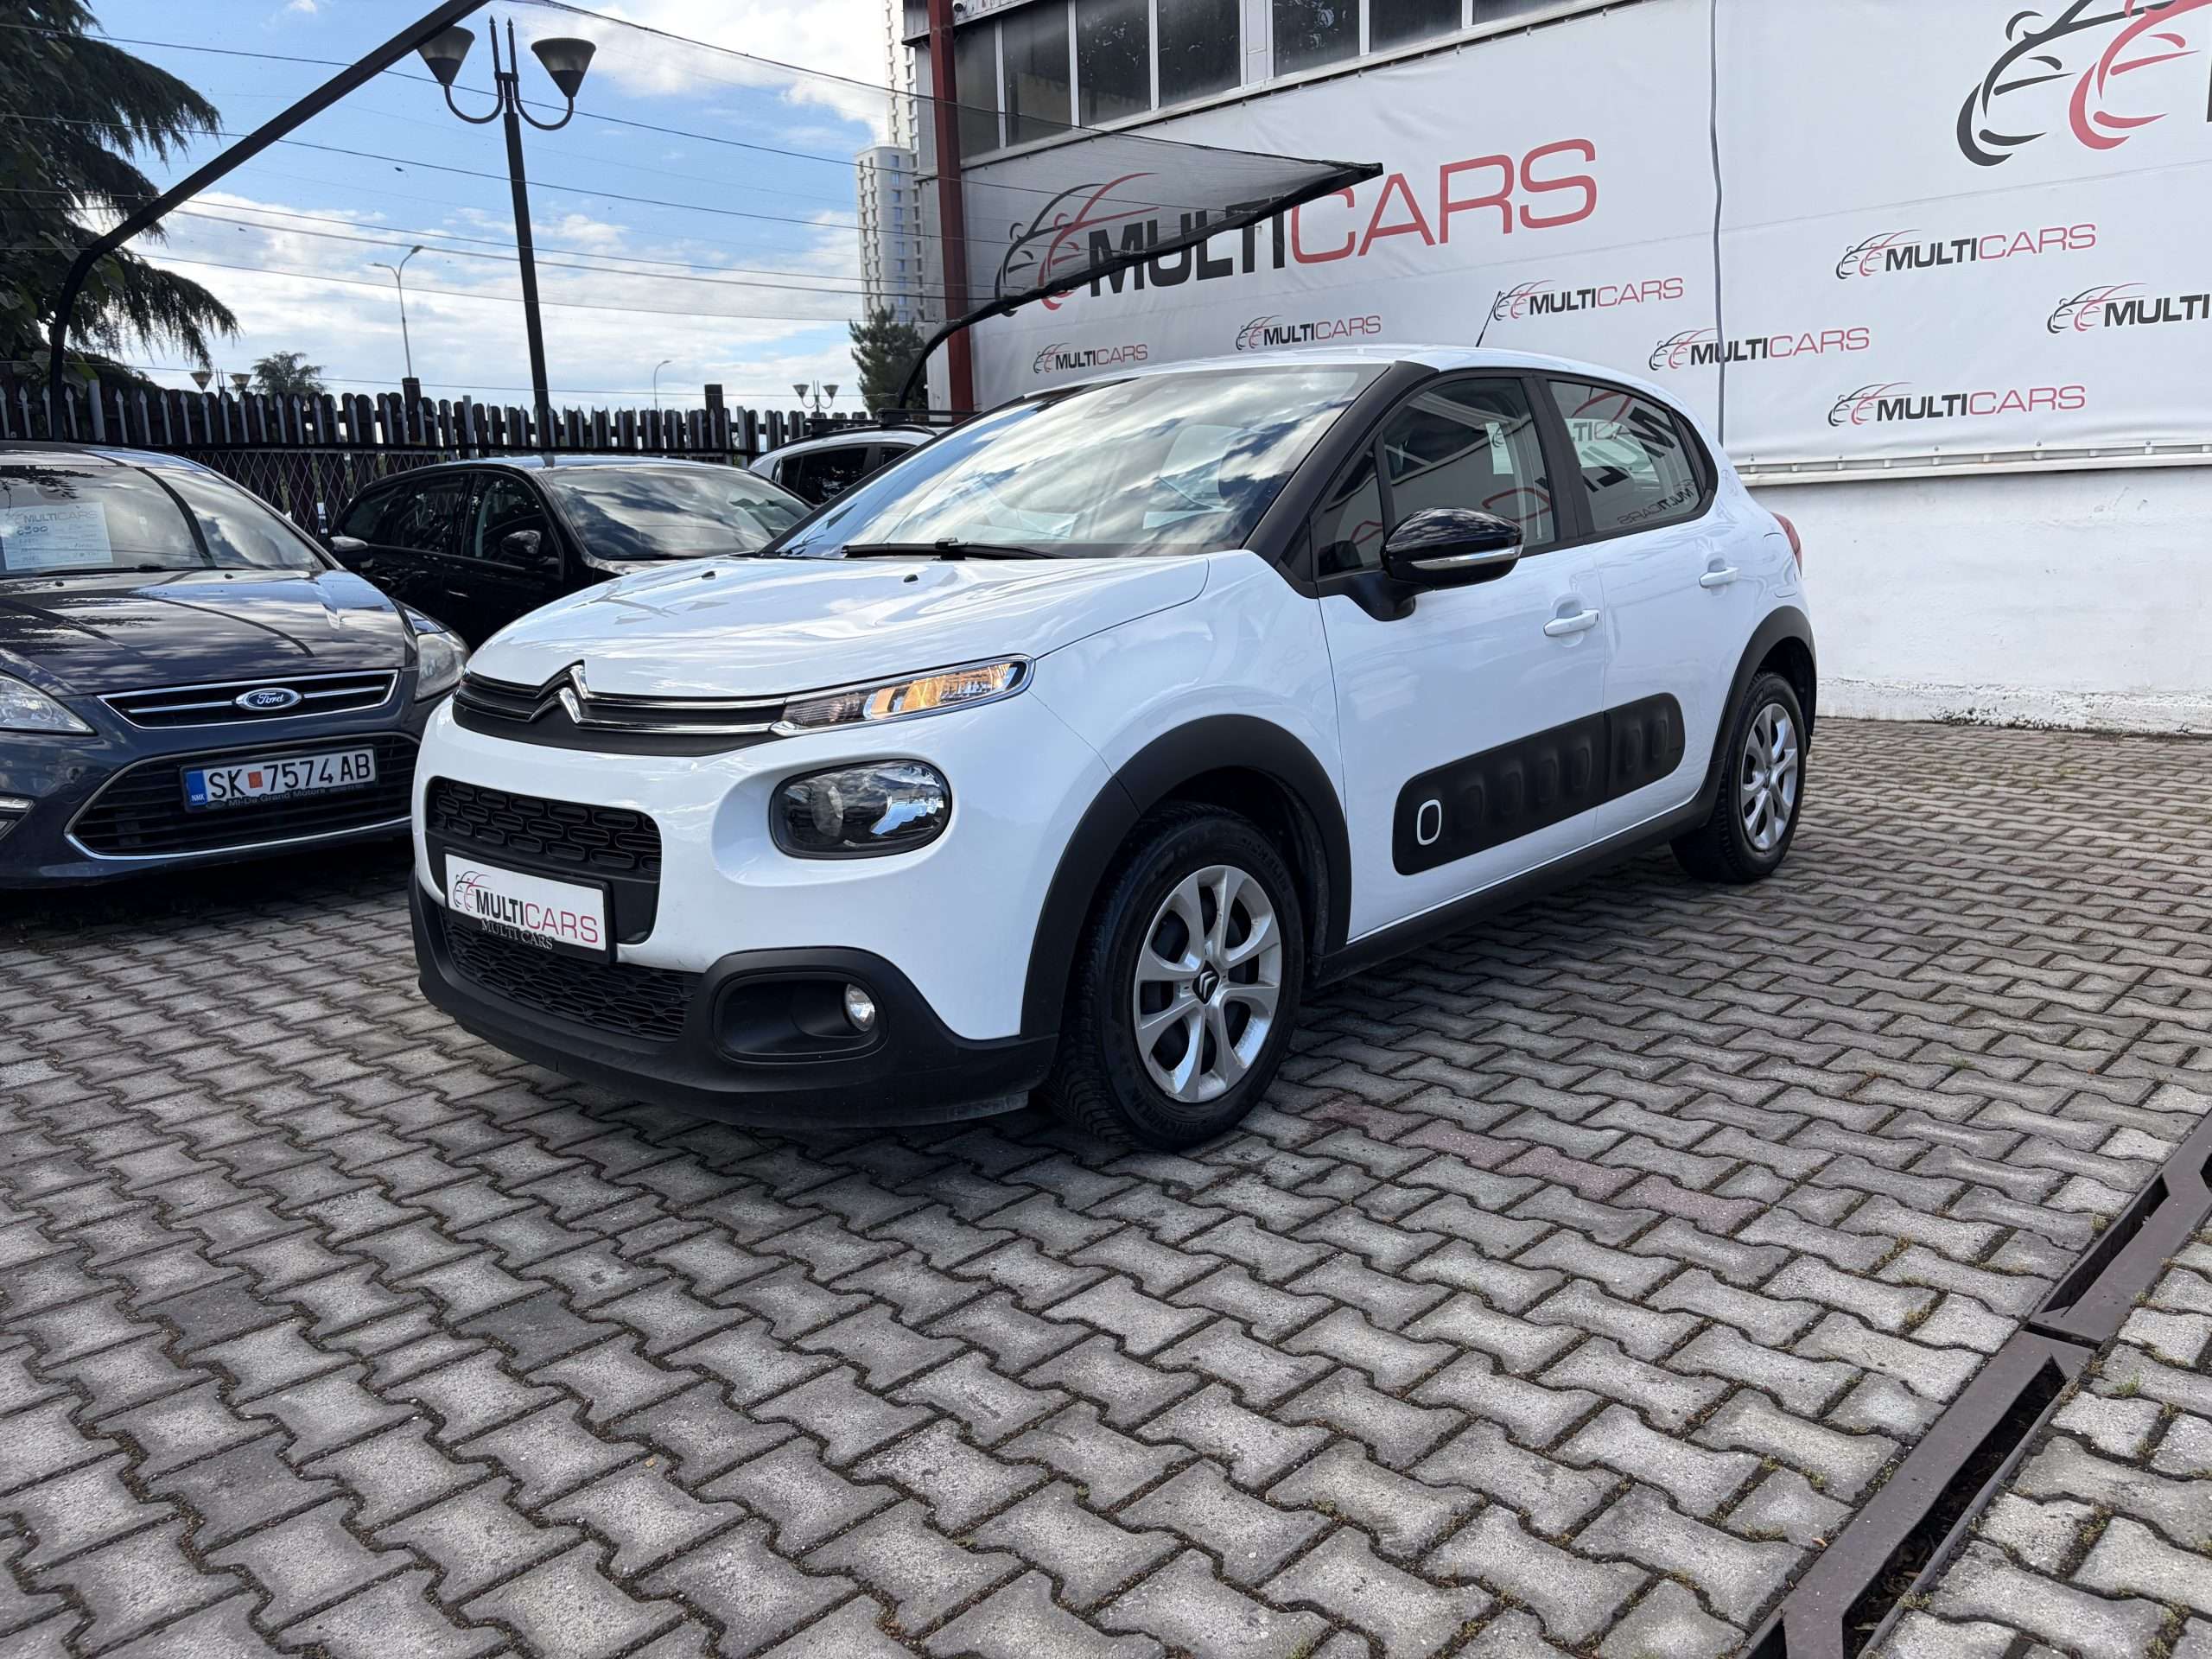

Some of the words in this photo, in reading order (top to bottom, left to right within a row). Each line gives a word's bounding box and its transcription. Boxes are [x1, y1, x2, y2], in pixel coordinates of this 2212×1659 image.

[1089, 138, 1597, 296] MULTICARS
[1884, 223, 2097, 272] MULTICARS
[1529, 277, 1684, 315] MULTICARS
[1262, 315, 1382, 346] MULTICARS
[1688, 327, 1871, 366] MULTICARS
[1054, 343, 1149, 371] MULTICARS
[1875, 385, 2086, 423] MULTICARS
[257, 692, 284, 705] Ford
[208, 768, 246, 799] SK
[263, 758, 334, 792] 7574
[340, 753, 371, 782] AB
[259, 791, 291, 803] Grand
[293, 787, 326, 798] Motors
[476, 888, 598, 944] MULTICARS
[480, 918, 518, 941] MULTI
[520, 930, 553, 950] CARS
